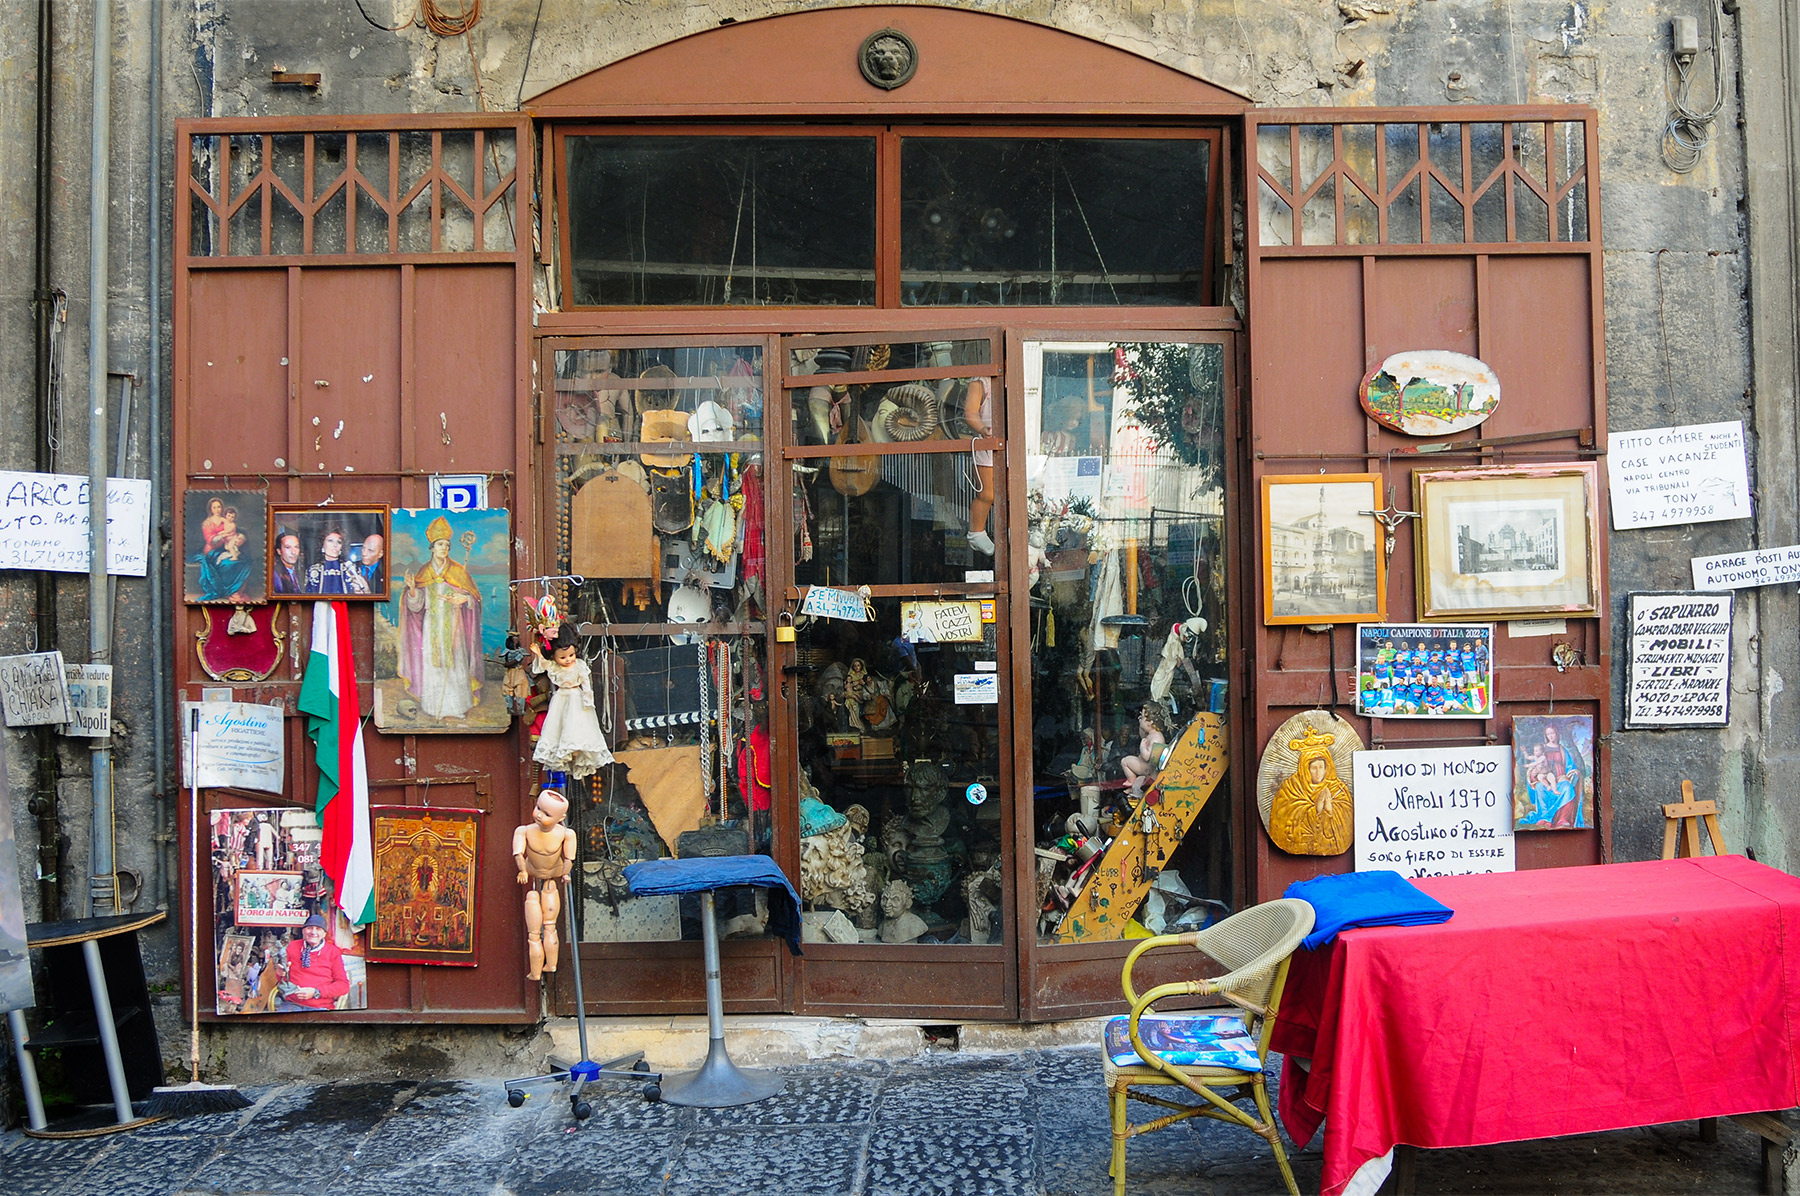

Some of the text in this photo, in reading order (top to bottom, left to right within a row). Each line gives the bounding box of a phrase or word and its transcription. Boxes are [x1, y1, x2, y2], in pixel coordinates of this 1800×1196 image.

[1619, 432, 1704, 449] FITTO CAMERE
[1704, 440, 1741, 451] STUDENTI
[1621, 451, 1718, 469] CASE VACANZE
[1624, 468, 1691, 482] NAPOLI CENTRO
[1626, 480, 1690, 495] VIA TRIBUNALI
[446, 487, 471, 508] P
[1664, 492, 1698, 504] TONY
[1632, 504, 1715, 522] 347 4979958
[1706, 550, 1800, 571] GARAGE POSTI AU
[1708, 568, 1768, 585] AUTONOMO
[934, 603, 968, 620] FATEVI
[1649, 603, 1720, 621] SAPUNARO
[1361, 628, 1389, 638] NAPOLI
[1390, 628, 1432, 638] CAMPIONE
[1668, 623, 1694, 635] ROBA
[1693, 622, 1729, 635] VECCHIA
[1649, 639, 1712, 651] MOBILI
[1634, 653, 1725, 664] STRUMENTI MUSICALI
[1651, 666, 1701, 677] LIBRI
[1635, 679, 1674, 690] STATUE
[1678, 678, 1723, 690] MADONNE
[1635, 692, 1671, 702] MOTO
[1654, 705, 1724, 717] 3474979958
[76, 711, 107, 734] Napoli
[205, 711, 268, 737] Agostino
[1368, 760, 1499, 779] UOMO DI MONDO
[1448, 788, 1496, 809] 1970
[292, 843, 311, 852] 347
[1367, 851, 1401, 862] SONO
[1451, 851, 1464, 859] DI
[1468, 847, 1505, 858] ESSERE
[297, 855, 314, 863] 081
[275, 910, 310, 918] NAPOLI
